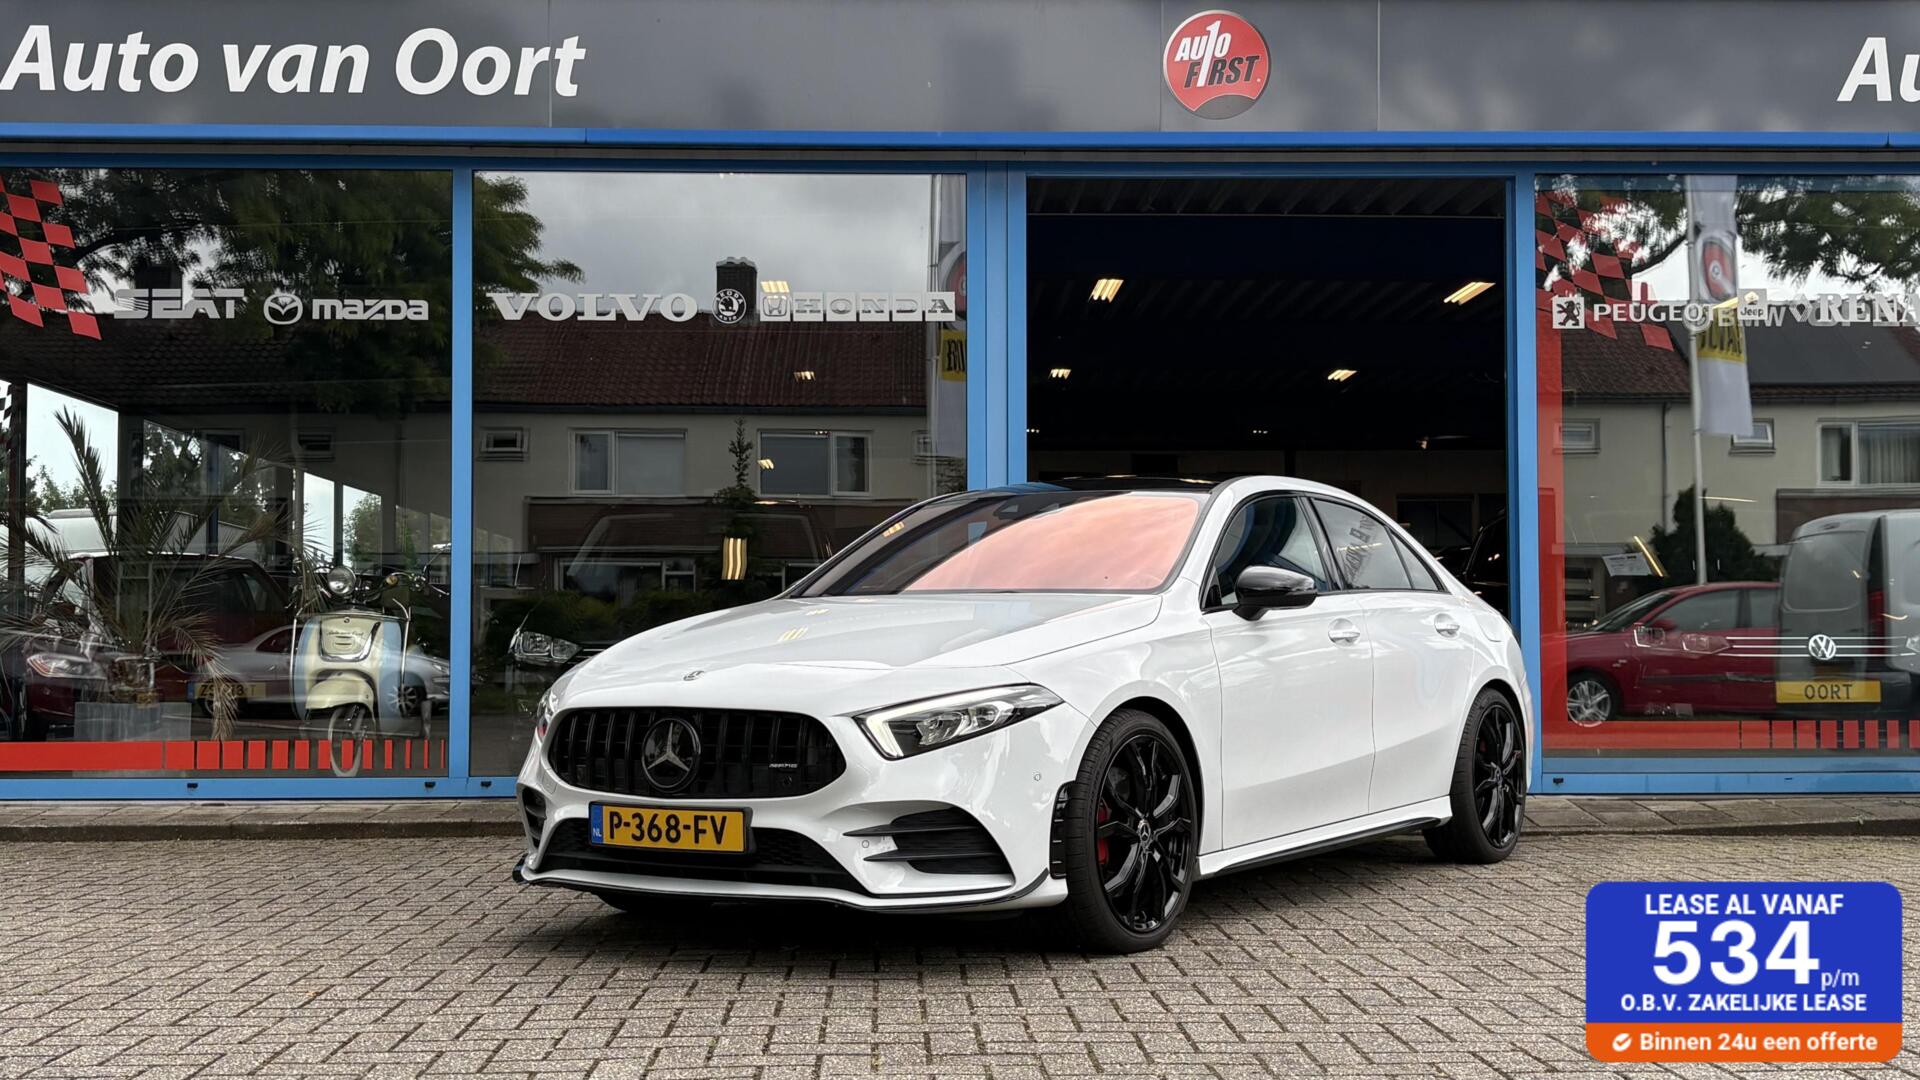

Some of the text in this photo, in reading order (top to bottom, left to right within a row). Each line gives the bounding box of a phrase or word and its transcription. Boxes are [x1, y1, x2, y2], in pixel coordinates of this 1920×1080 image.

[0, 24, 586, 97] Auto van Oort
[113, 288, 245, 319] SEAT
[486, 292, 698, 322] VOLVO
[794, 296, 954, 317] HONDA
[1593, 303, 1714, 323] PEUGEOT
[1740, 307, 1764, 317] Jeep
[1804, 683, 1853, 700] OORT
[608, 810, 728, 845] P-368-FV
